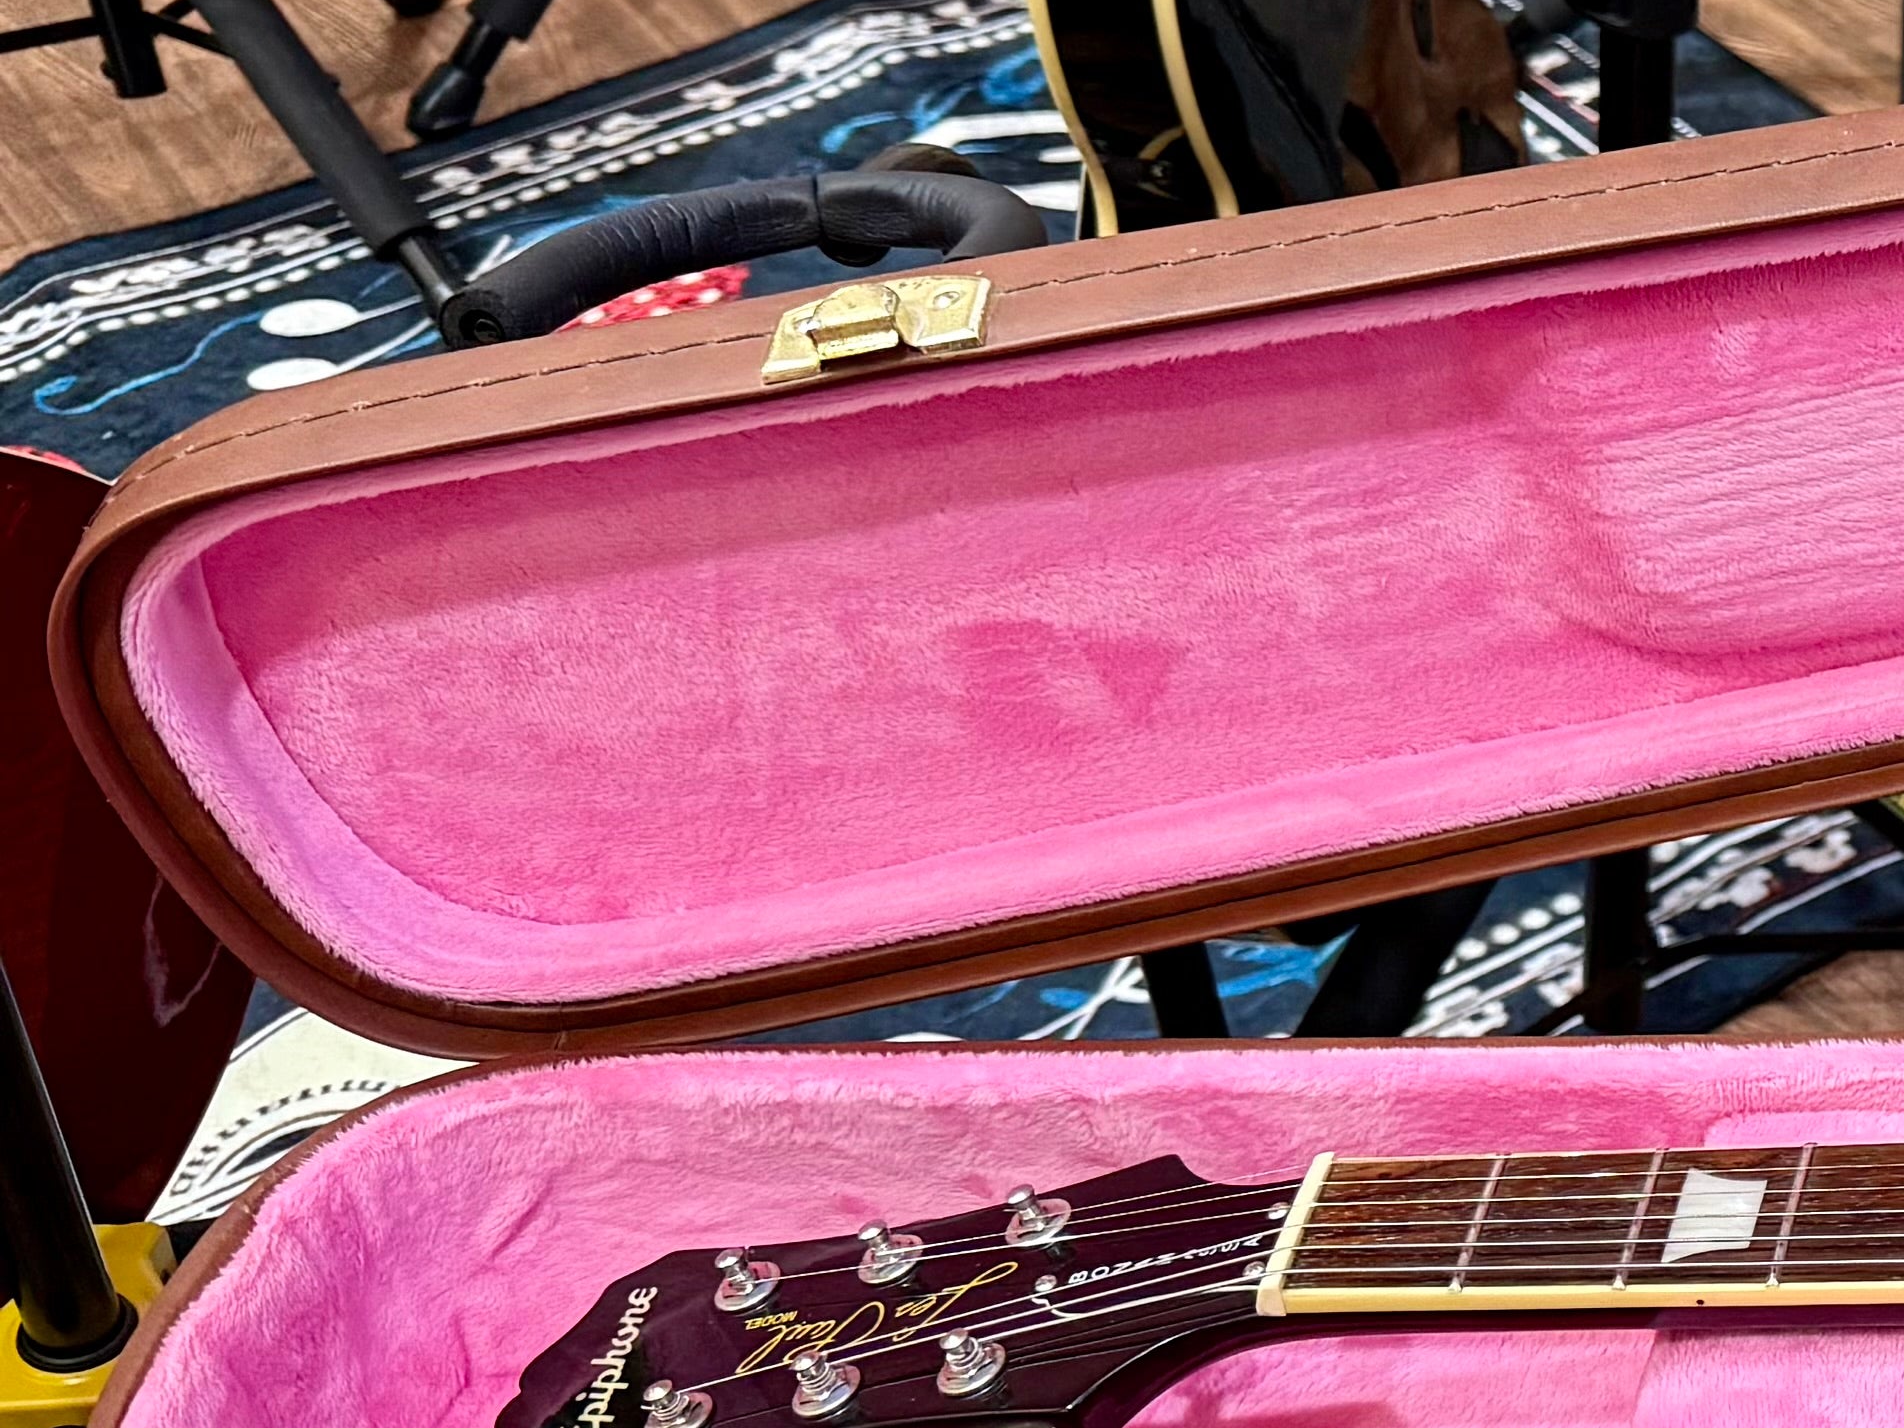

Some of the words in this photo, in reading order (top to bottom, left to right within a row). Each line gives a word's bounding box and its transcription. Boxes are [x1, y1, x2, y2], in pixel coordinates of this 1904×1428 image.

[1068, 1234, 1264, 1285] BONAMASSA
[744, 1310, 798, 1331] MODEL
[892, 1261, 1019, 1342] Les
[734, 1300, 886, 1375] Paul
